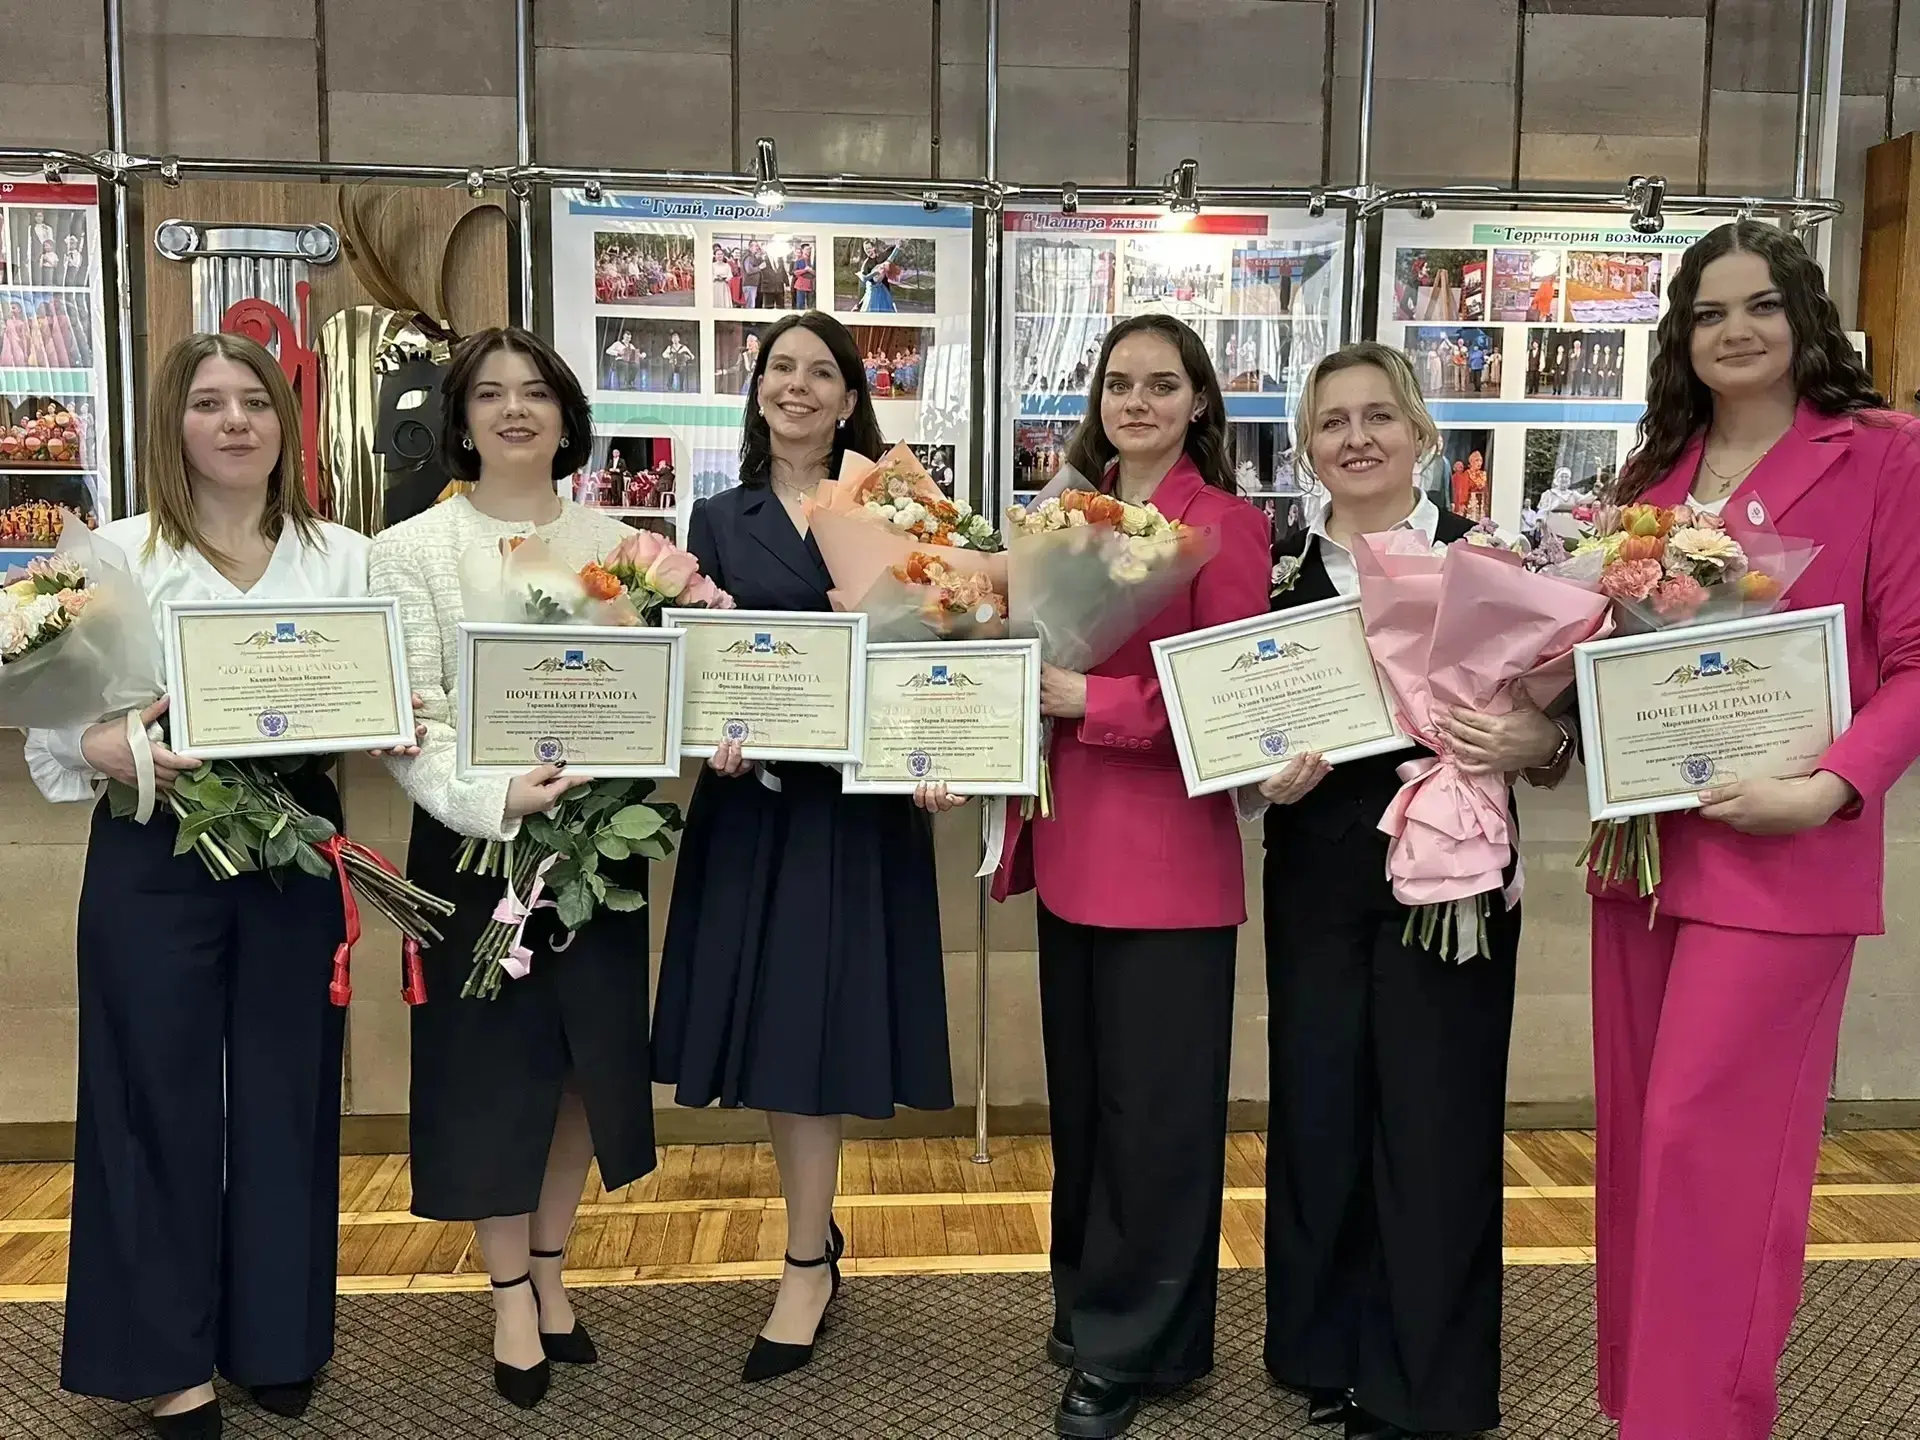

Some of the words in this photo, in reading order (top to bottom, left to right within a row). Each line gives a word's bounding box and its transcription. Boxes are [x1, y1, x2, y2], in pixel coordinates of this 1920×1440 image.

[1111, 218, 1158, 230] жизн
[701, 671, 764, 681] ПОЧЕТНАЯ
[768, 673, 820, 683] ГРАМОТА
[1211, 680, 1281, 705] ПОЧЕТНАЯ
[1283, 665, 1342, 687] ГРАМОТА
[505, 689, 576, 699] ПОЧЕТНАЯ
[580, 690, 637, 700] ГРАМОТА
[945, 704, 995, 714] ГРАМОТА
[1635, 700, 1718, 722] ПОЧЕТНАЯ
[1722, 689, 1791, 709] ГРАМОТА
